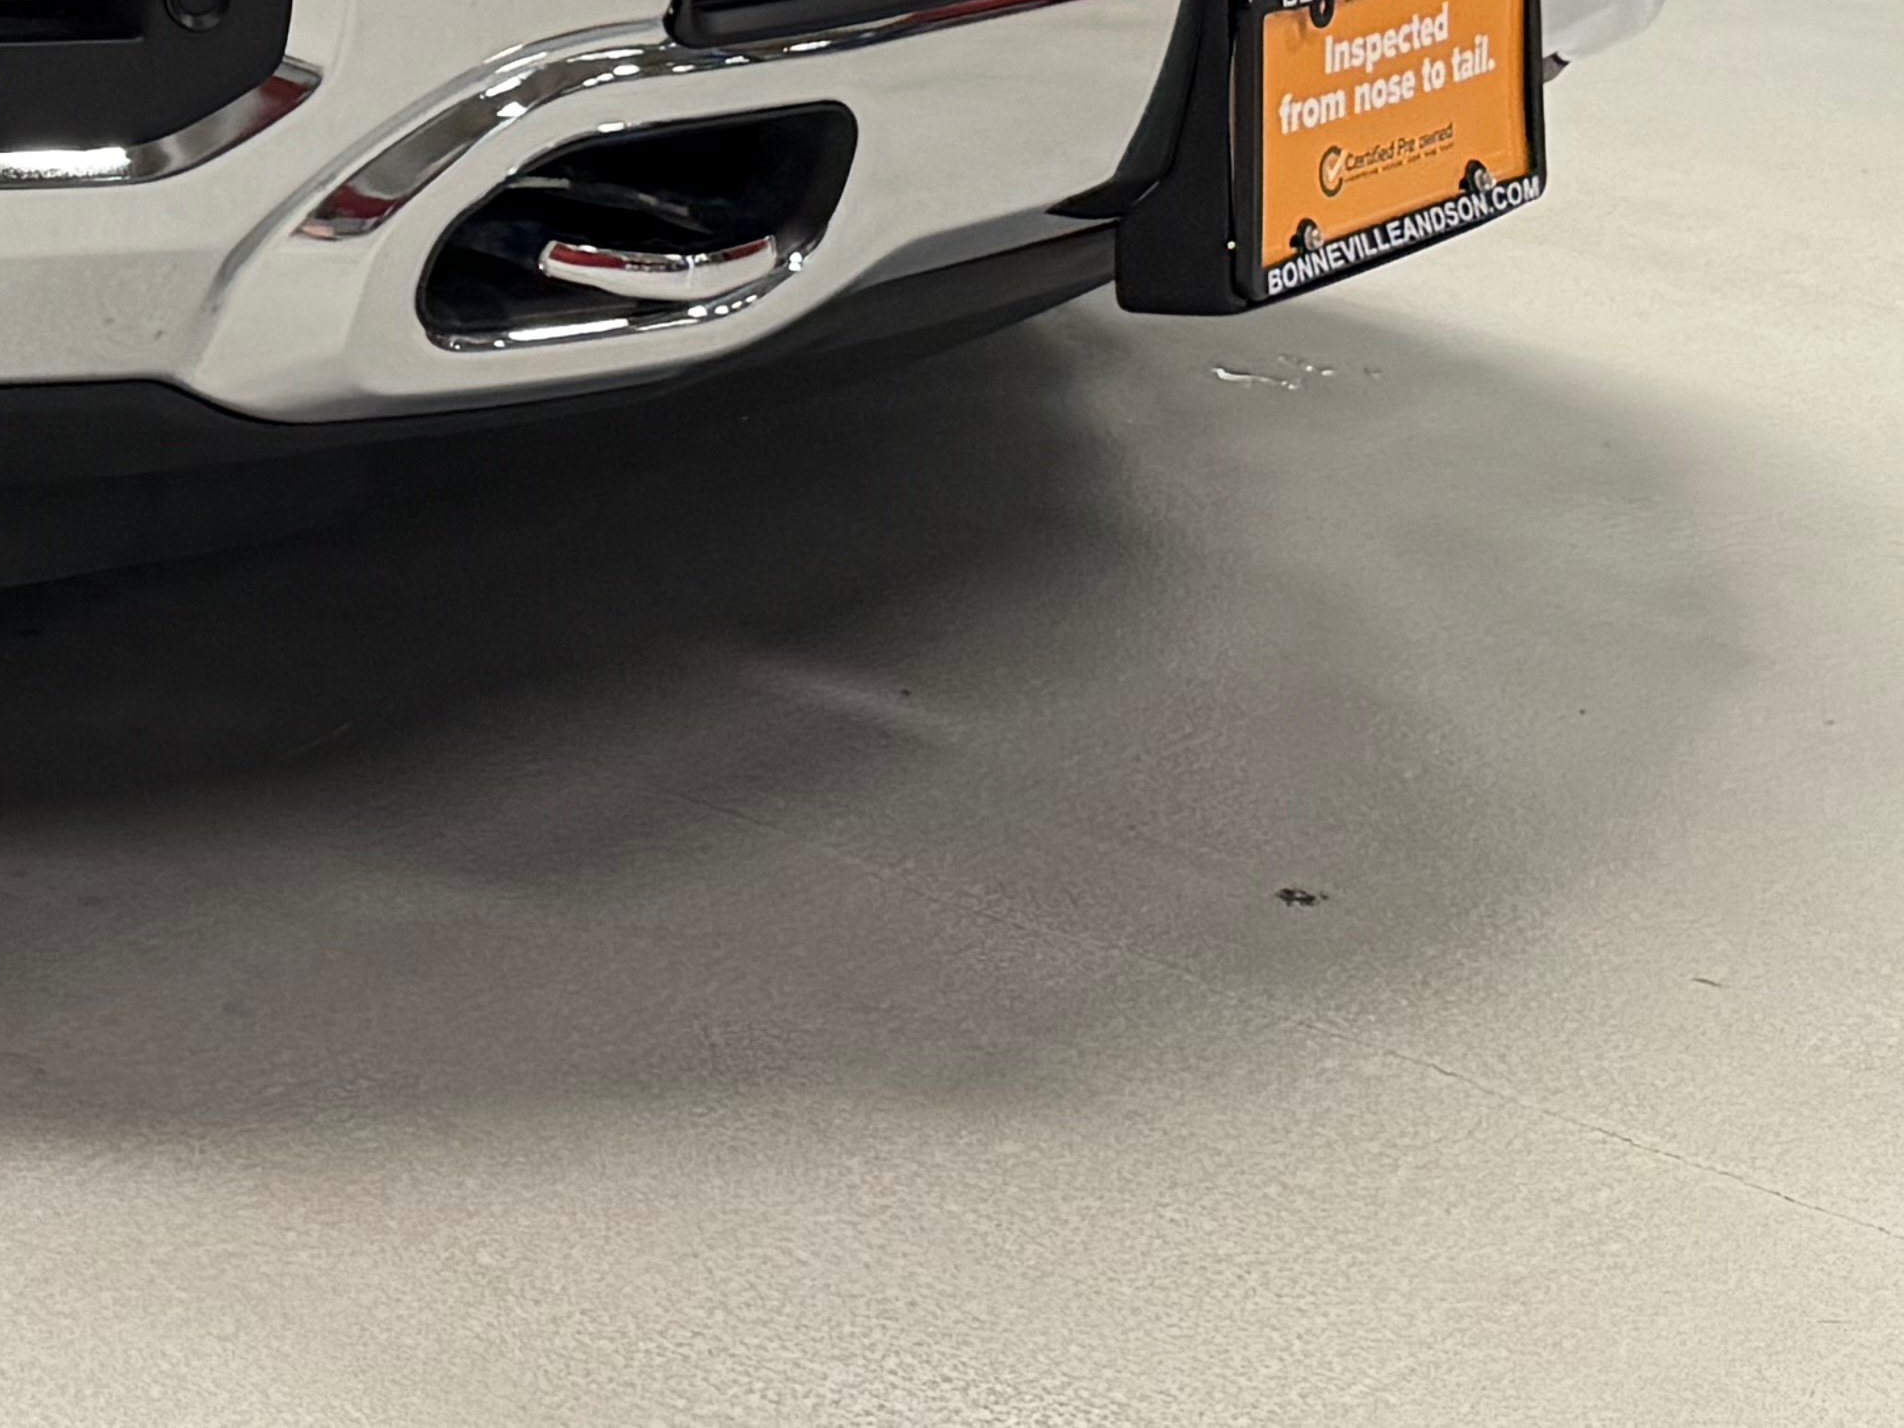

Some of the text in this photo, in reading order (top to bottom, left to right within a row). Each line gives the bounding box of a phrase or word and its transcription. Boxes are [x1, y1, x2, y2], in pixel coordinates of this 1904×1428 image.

[1279, 34, 1496, 135] from nose to tail.
[1324, 1, 1450, 75] Inspected
[1267, 175, 1540, 295] BONNEVILLEANDSON.COM
